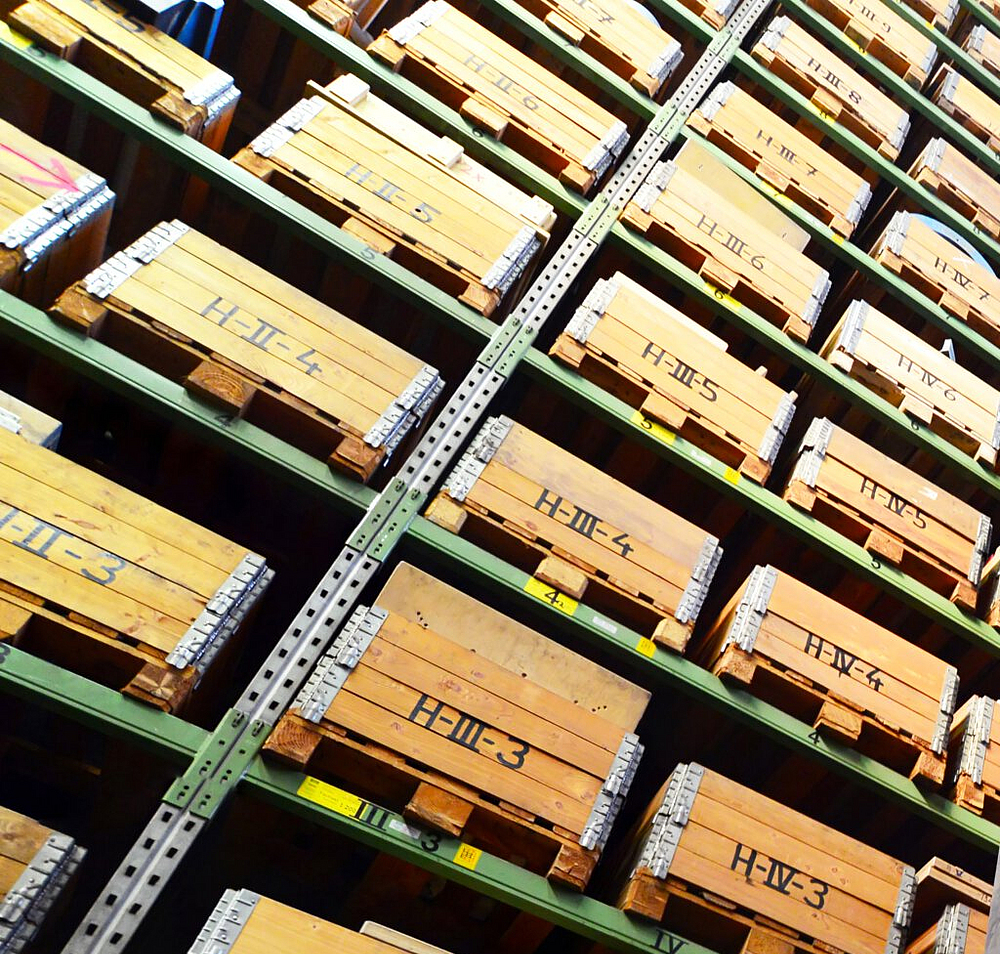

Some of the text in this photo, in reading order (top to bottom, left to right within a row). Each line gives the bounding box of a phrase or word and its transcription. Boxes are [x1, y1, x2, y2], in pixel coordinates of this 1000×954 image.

[463, 55, 540, 111] H-II-6
[807, 57, 862, 105] H-III-8
[755, 129, 819, 178] H-III-7
[345, 163, 442, 223] H-II-5
[696, 213, 766, 271] H-III-6
[934, 256, 991, 302] H-IV-7
[201, 296, 322, 375] H-II-4
[641, 343, 718, 402] H-III-5
[897, 354, 958, 403] H-IV-6
[534, 488, 634, 557] H-III-4
[859, 477, 928, 531] H-IV-5
[802, 632, 886, 694] H-IV-4
[407, 693, 532, 771] H-III-3
[420, 831, 443, 853] 3
[730, 842, 831, 911] H-IV-3
